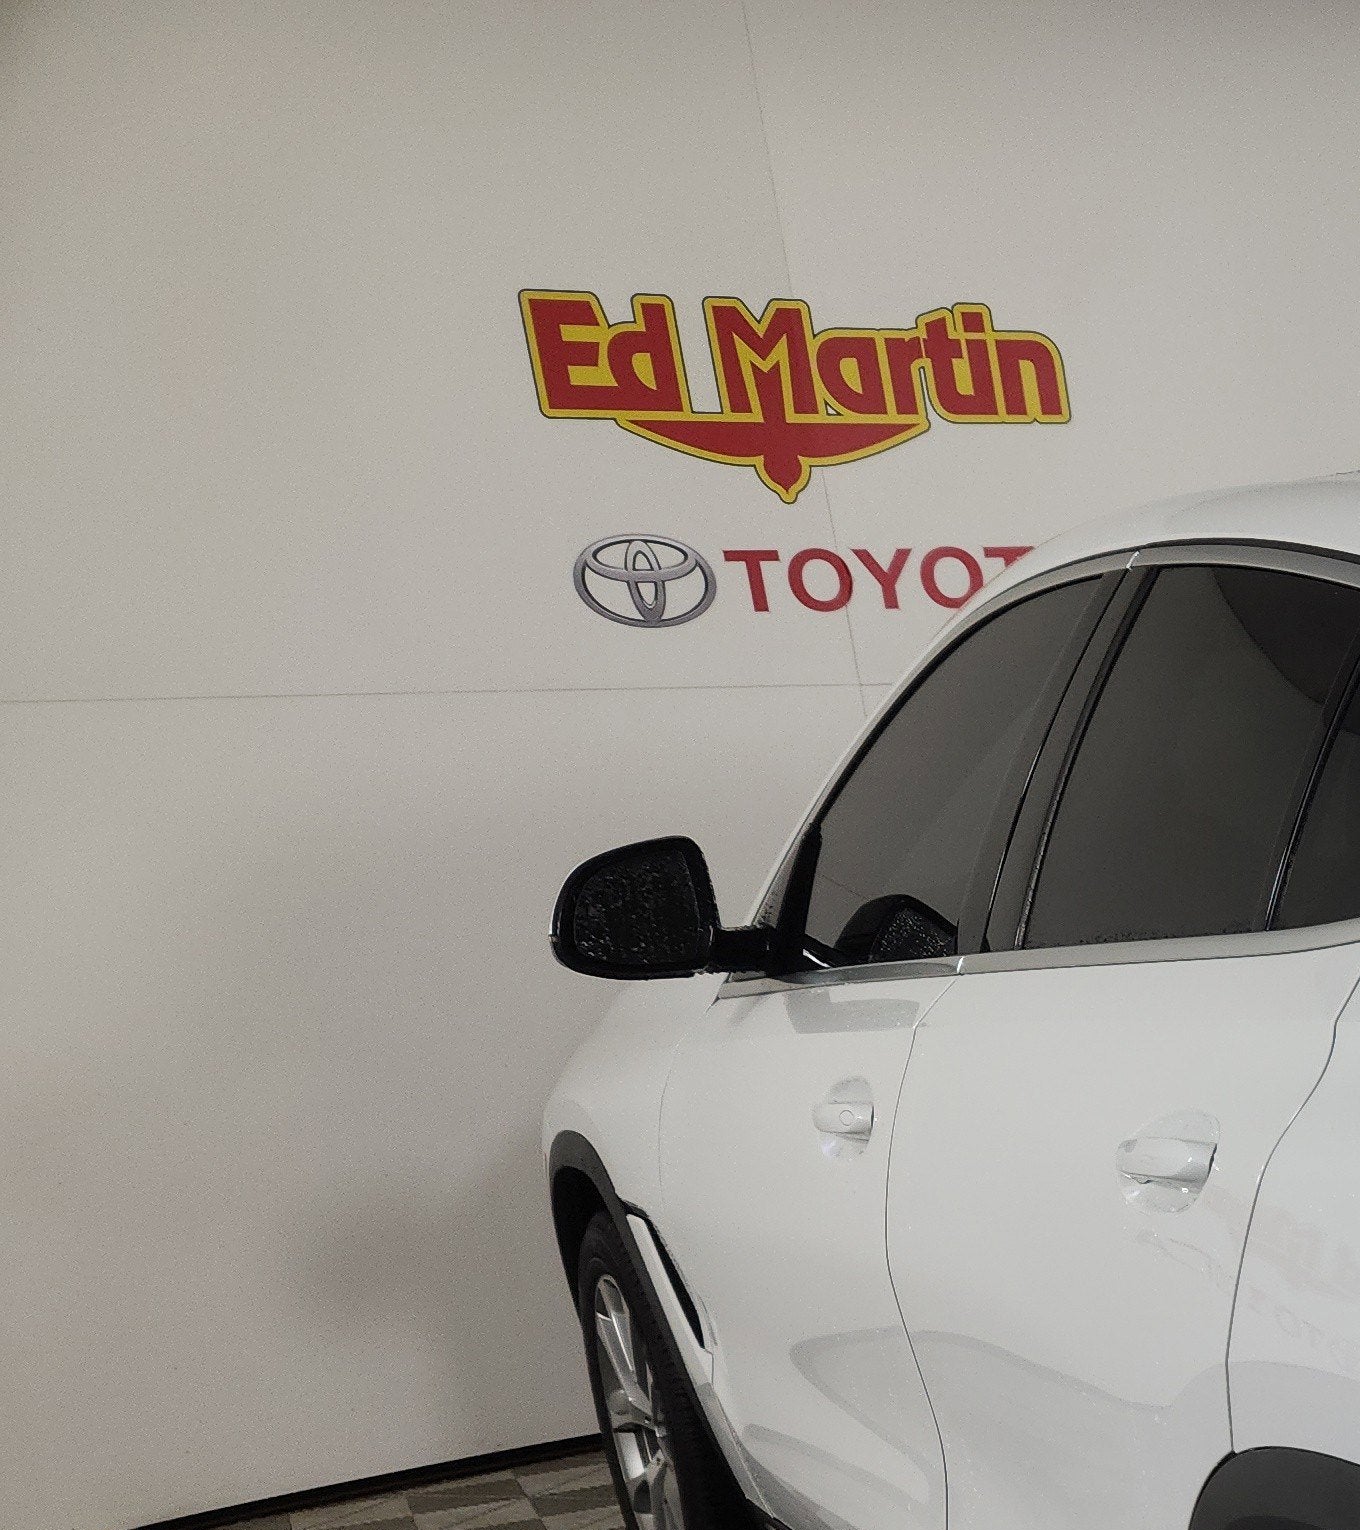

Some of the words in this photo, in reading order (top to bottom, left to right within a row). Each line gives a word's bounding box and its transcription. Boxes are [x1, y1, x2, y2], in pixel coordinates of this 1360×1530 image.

[525, 293, 688, 414] Ed
[706, 299, 1066, 418] Martin
[723, 545, 1035, 613] TOYOT
